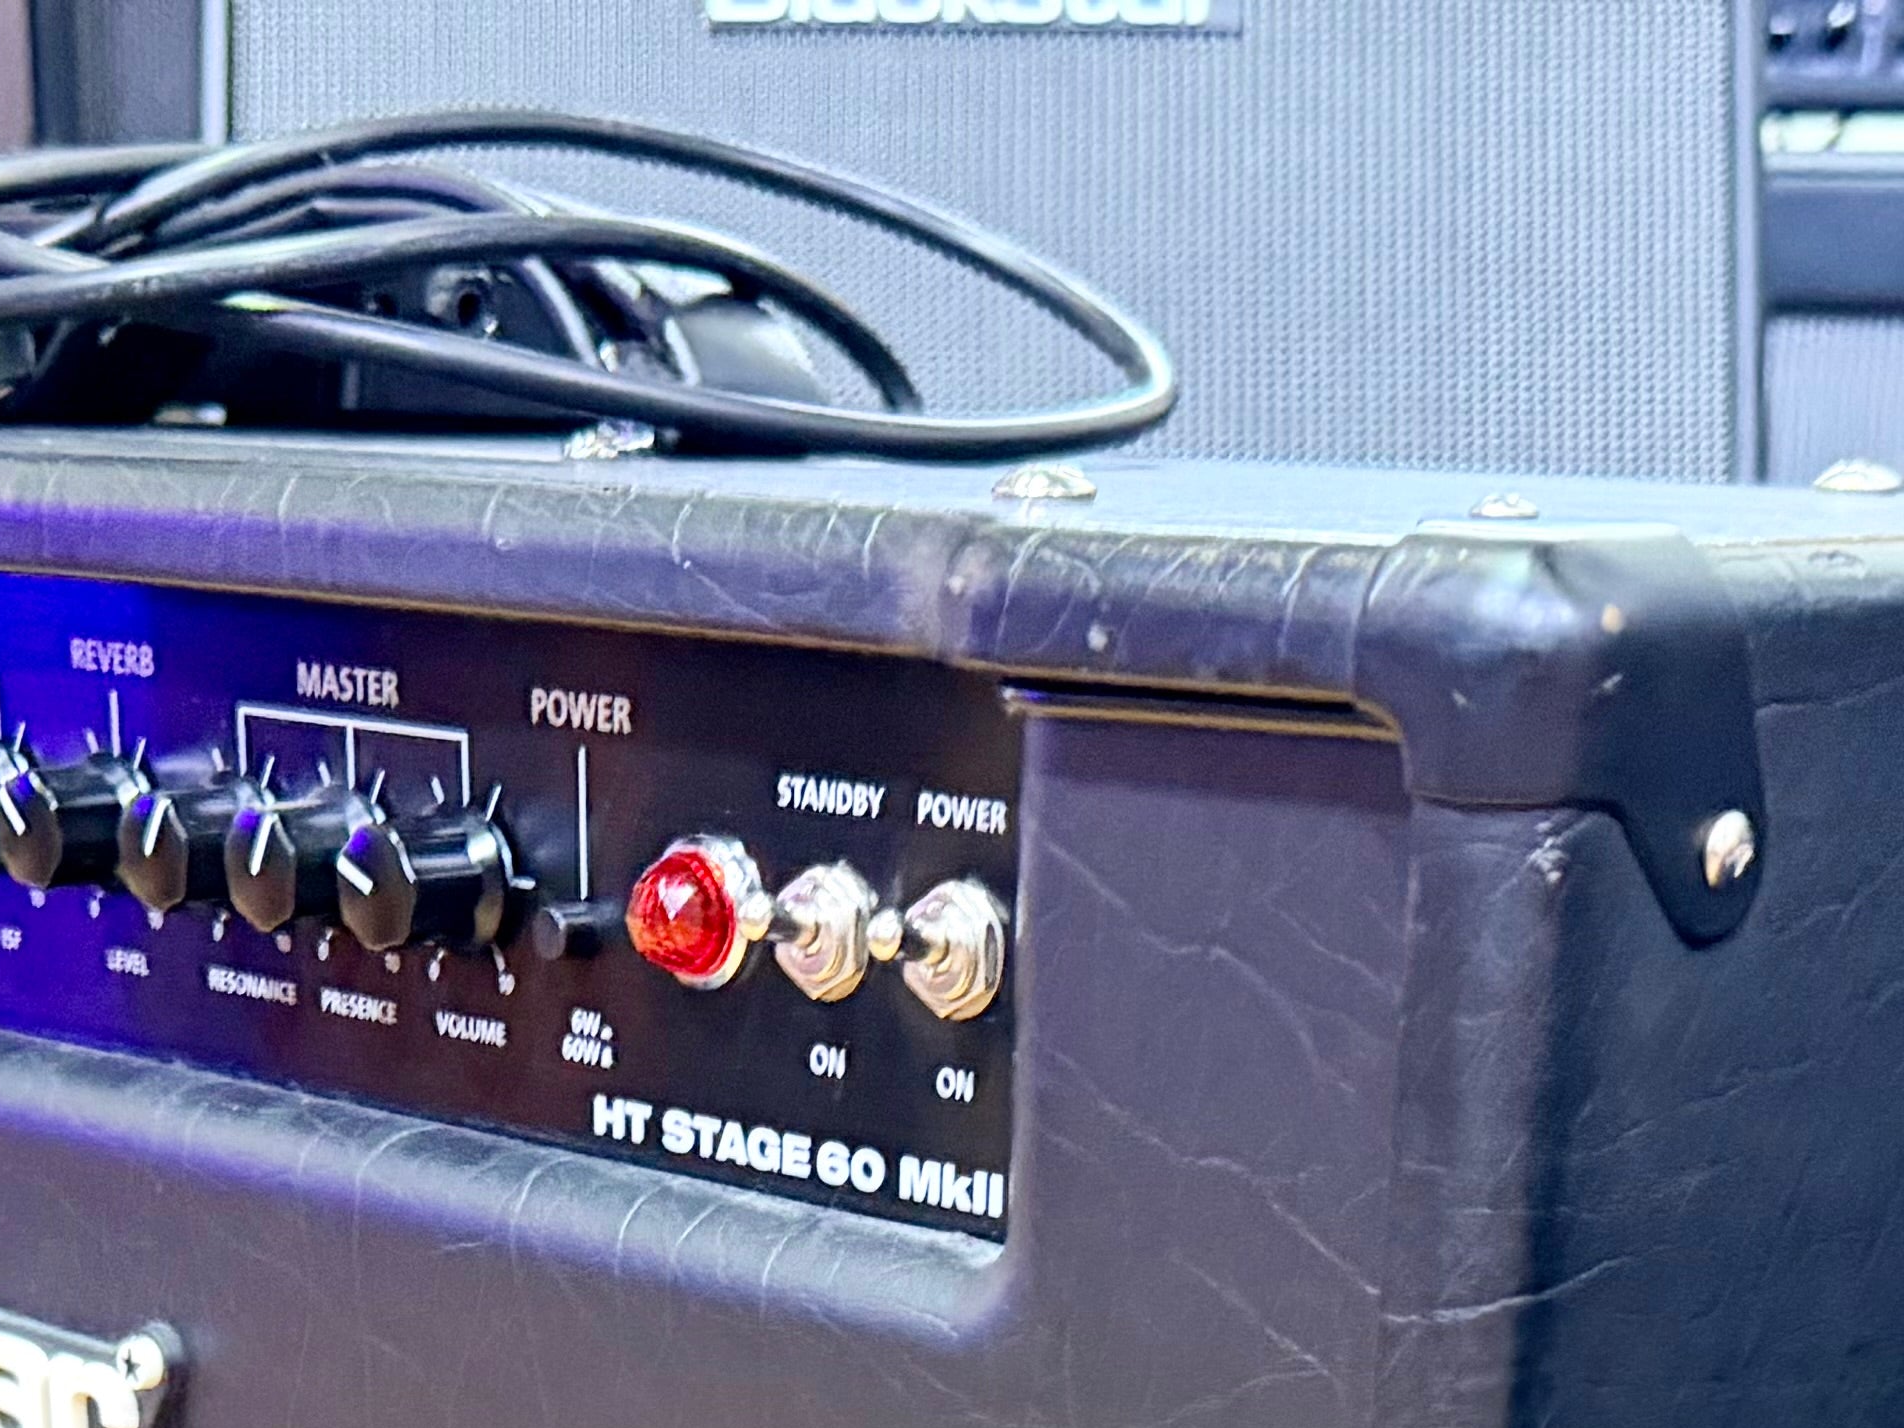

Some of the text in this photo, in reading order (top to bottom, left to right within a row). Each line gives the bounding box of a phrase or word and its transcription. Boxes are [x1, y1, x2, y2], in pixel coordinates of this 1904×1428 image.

[70, 638, 155, 678] REVERB
[297, 661, 399, 708] MASTER
[530, 687, 632, 735] POWER
[777, 774, 885, 820] STANDBY
[918, 791, 1008, 835] POWER
[105, 948, 150, 977] LEVEL
[207, 963, 297, 1007] RESONANCE
[319, 987, 398, 1026] PRESENCE
[436, 1010, 508, 1048] VOLUME
[809, 1044, 847, 1080] ON
[935, 1066, 975, 1102] ON
[594, 1094, 1004, 1219] HT STAGE 60 MkII
